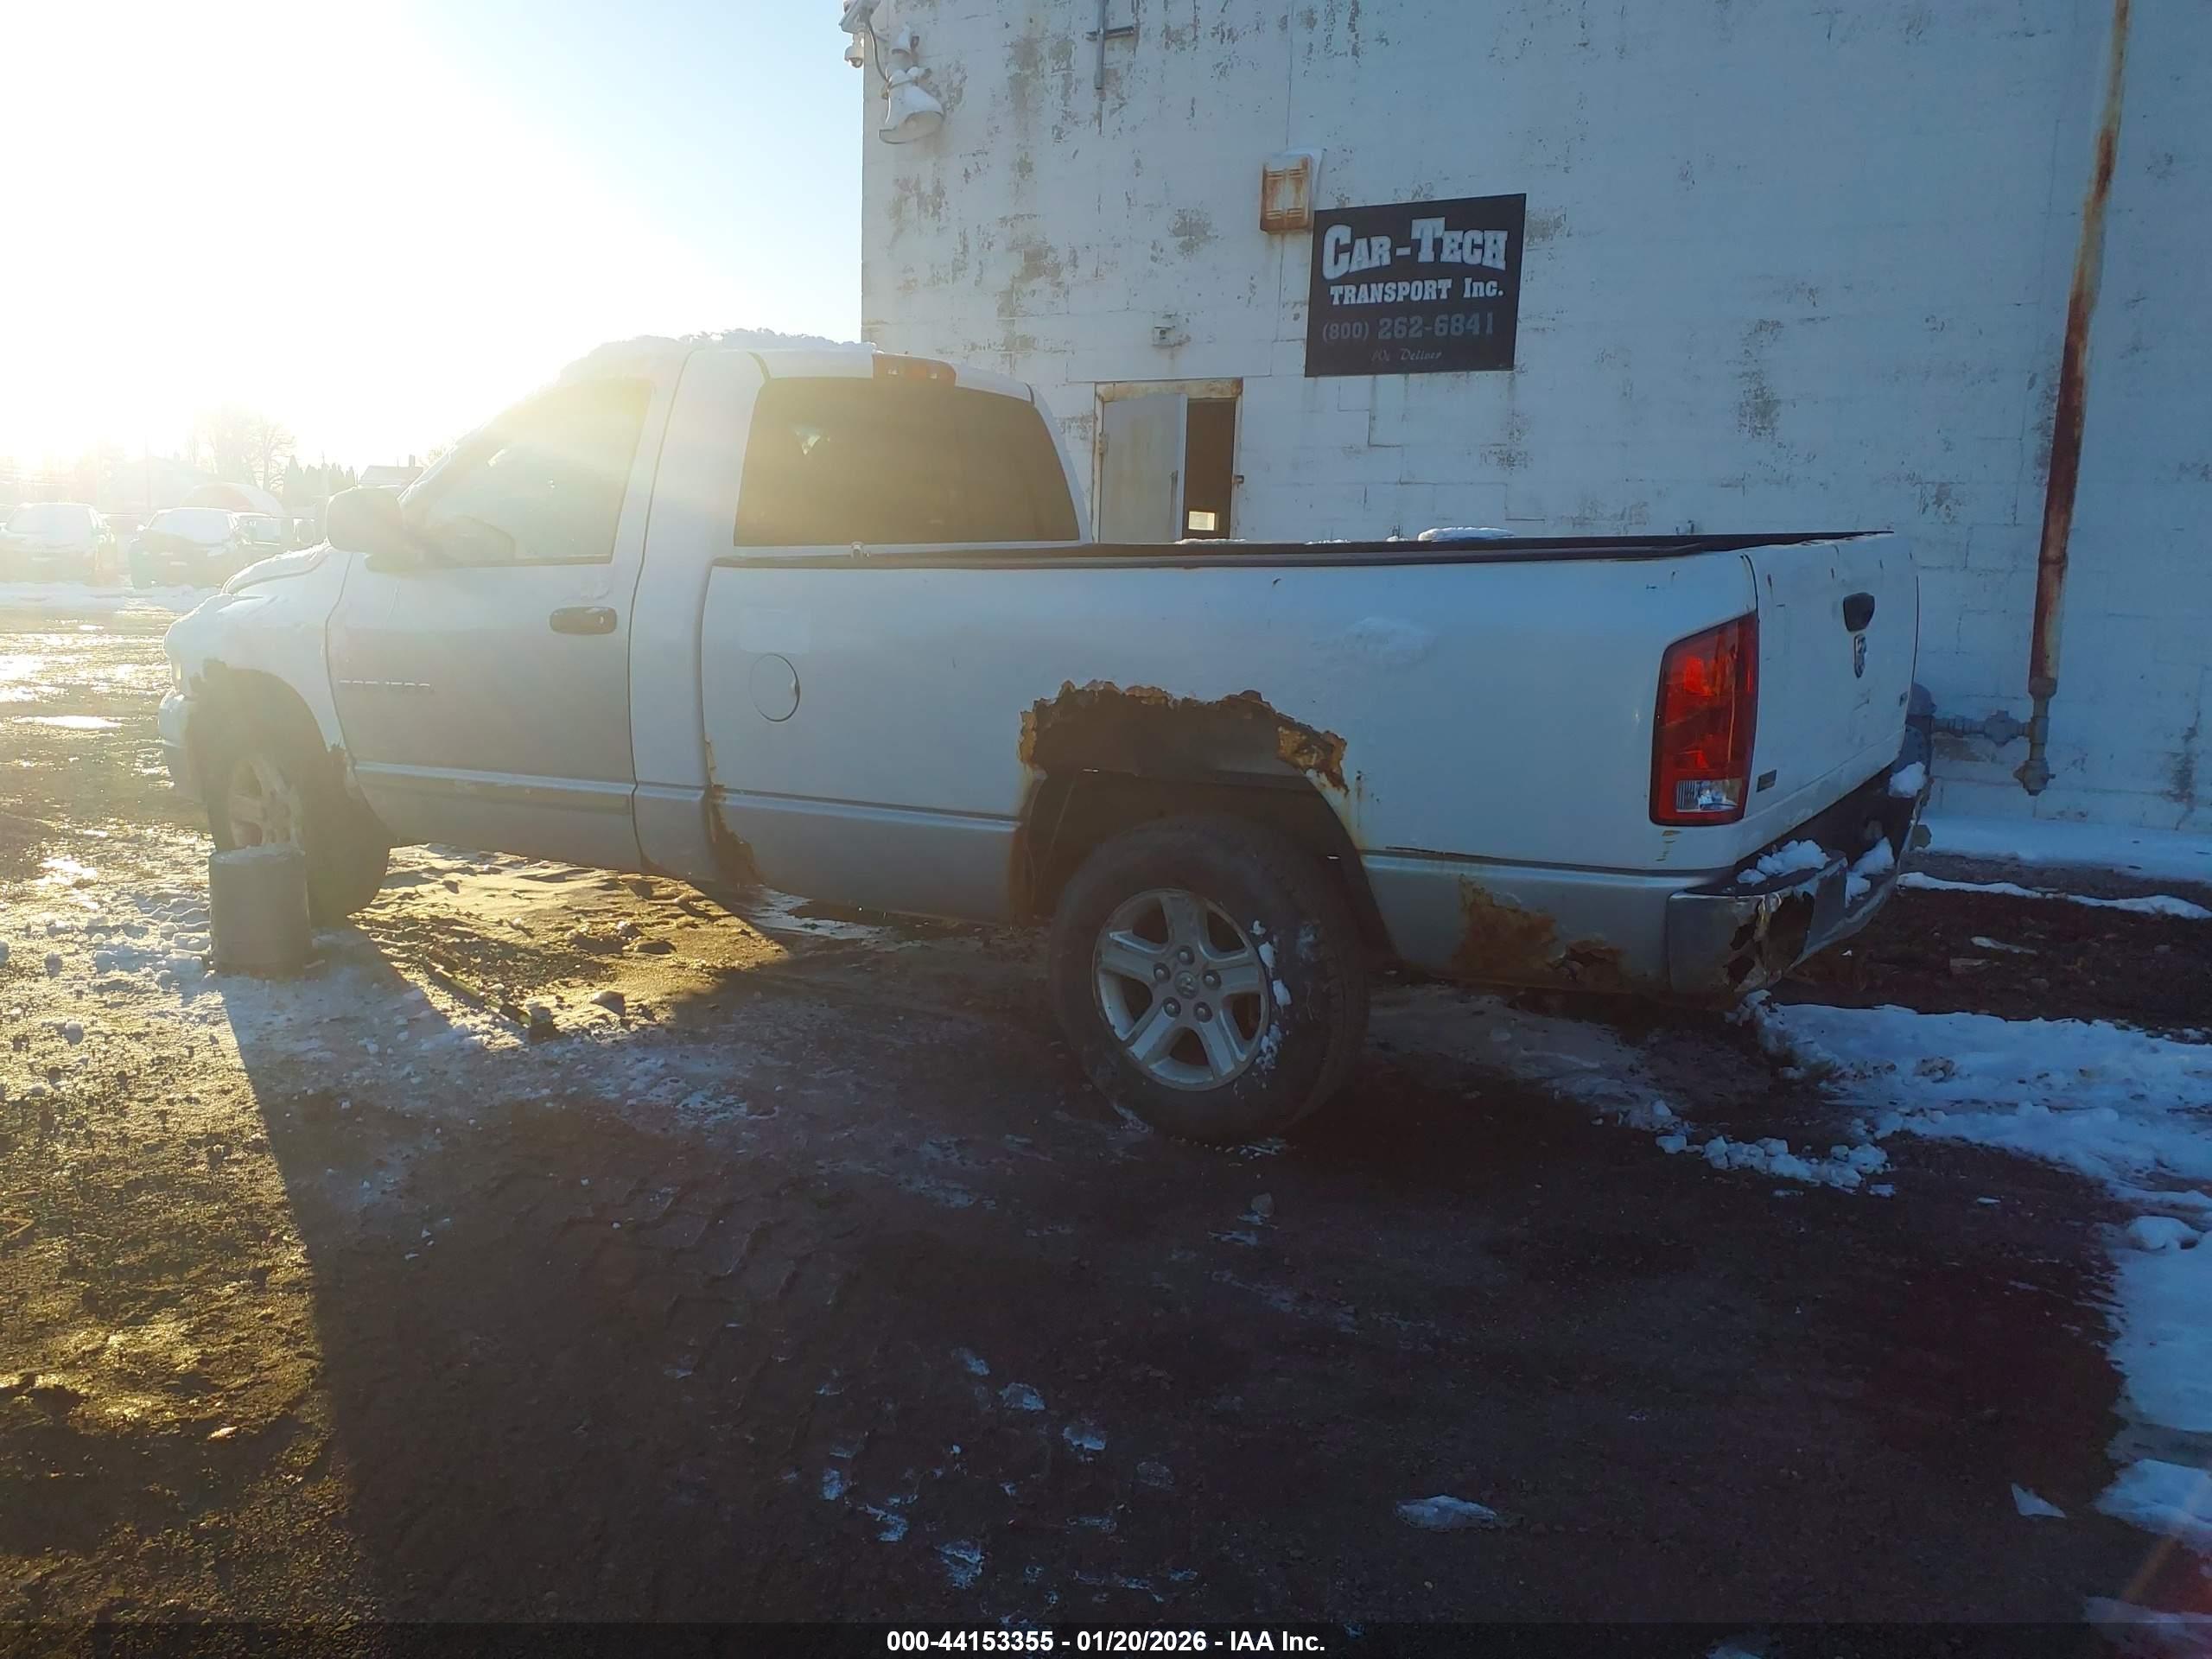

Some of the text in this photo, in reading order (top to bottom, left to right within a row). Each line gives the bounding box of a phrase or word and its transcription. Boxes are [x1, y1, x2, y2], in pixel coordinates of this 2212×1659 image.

[1330, 277, 1504, 306] TRANSPORT Inc.
[1322, 312, 1493, 344] (800) 262-6841
